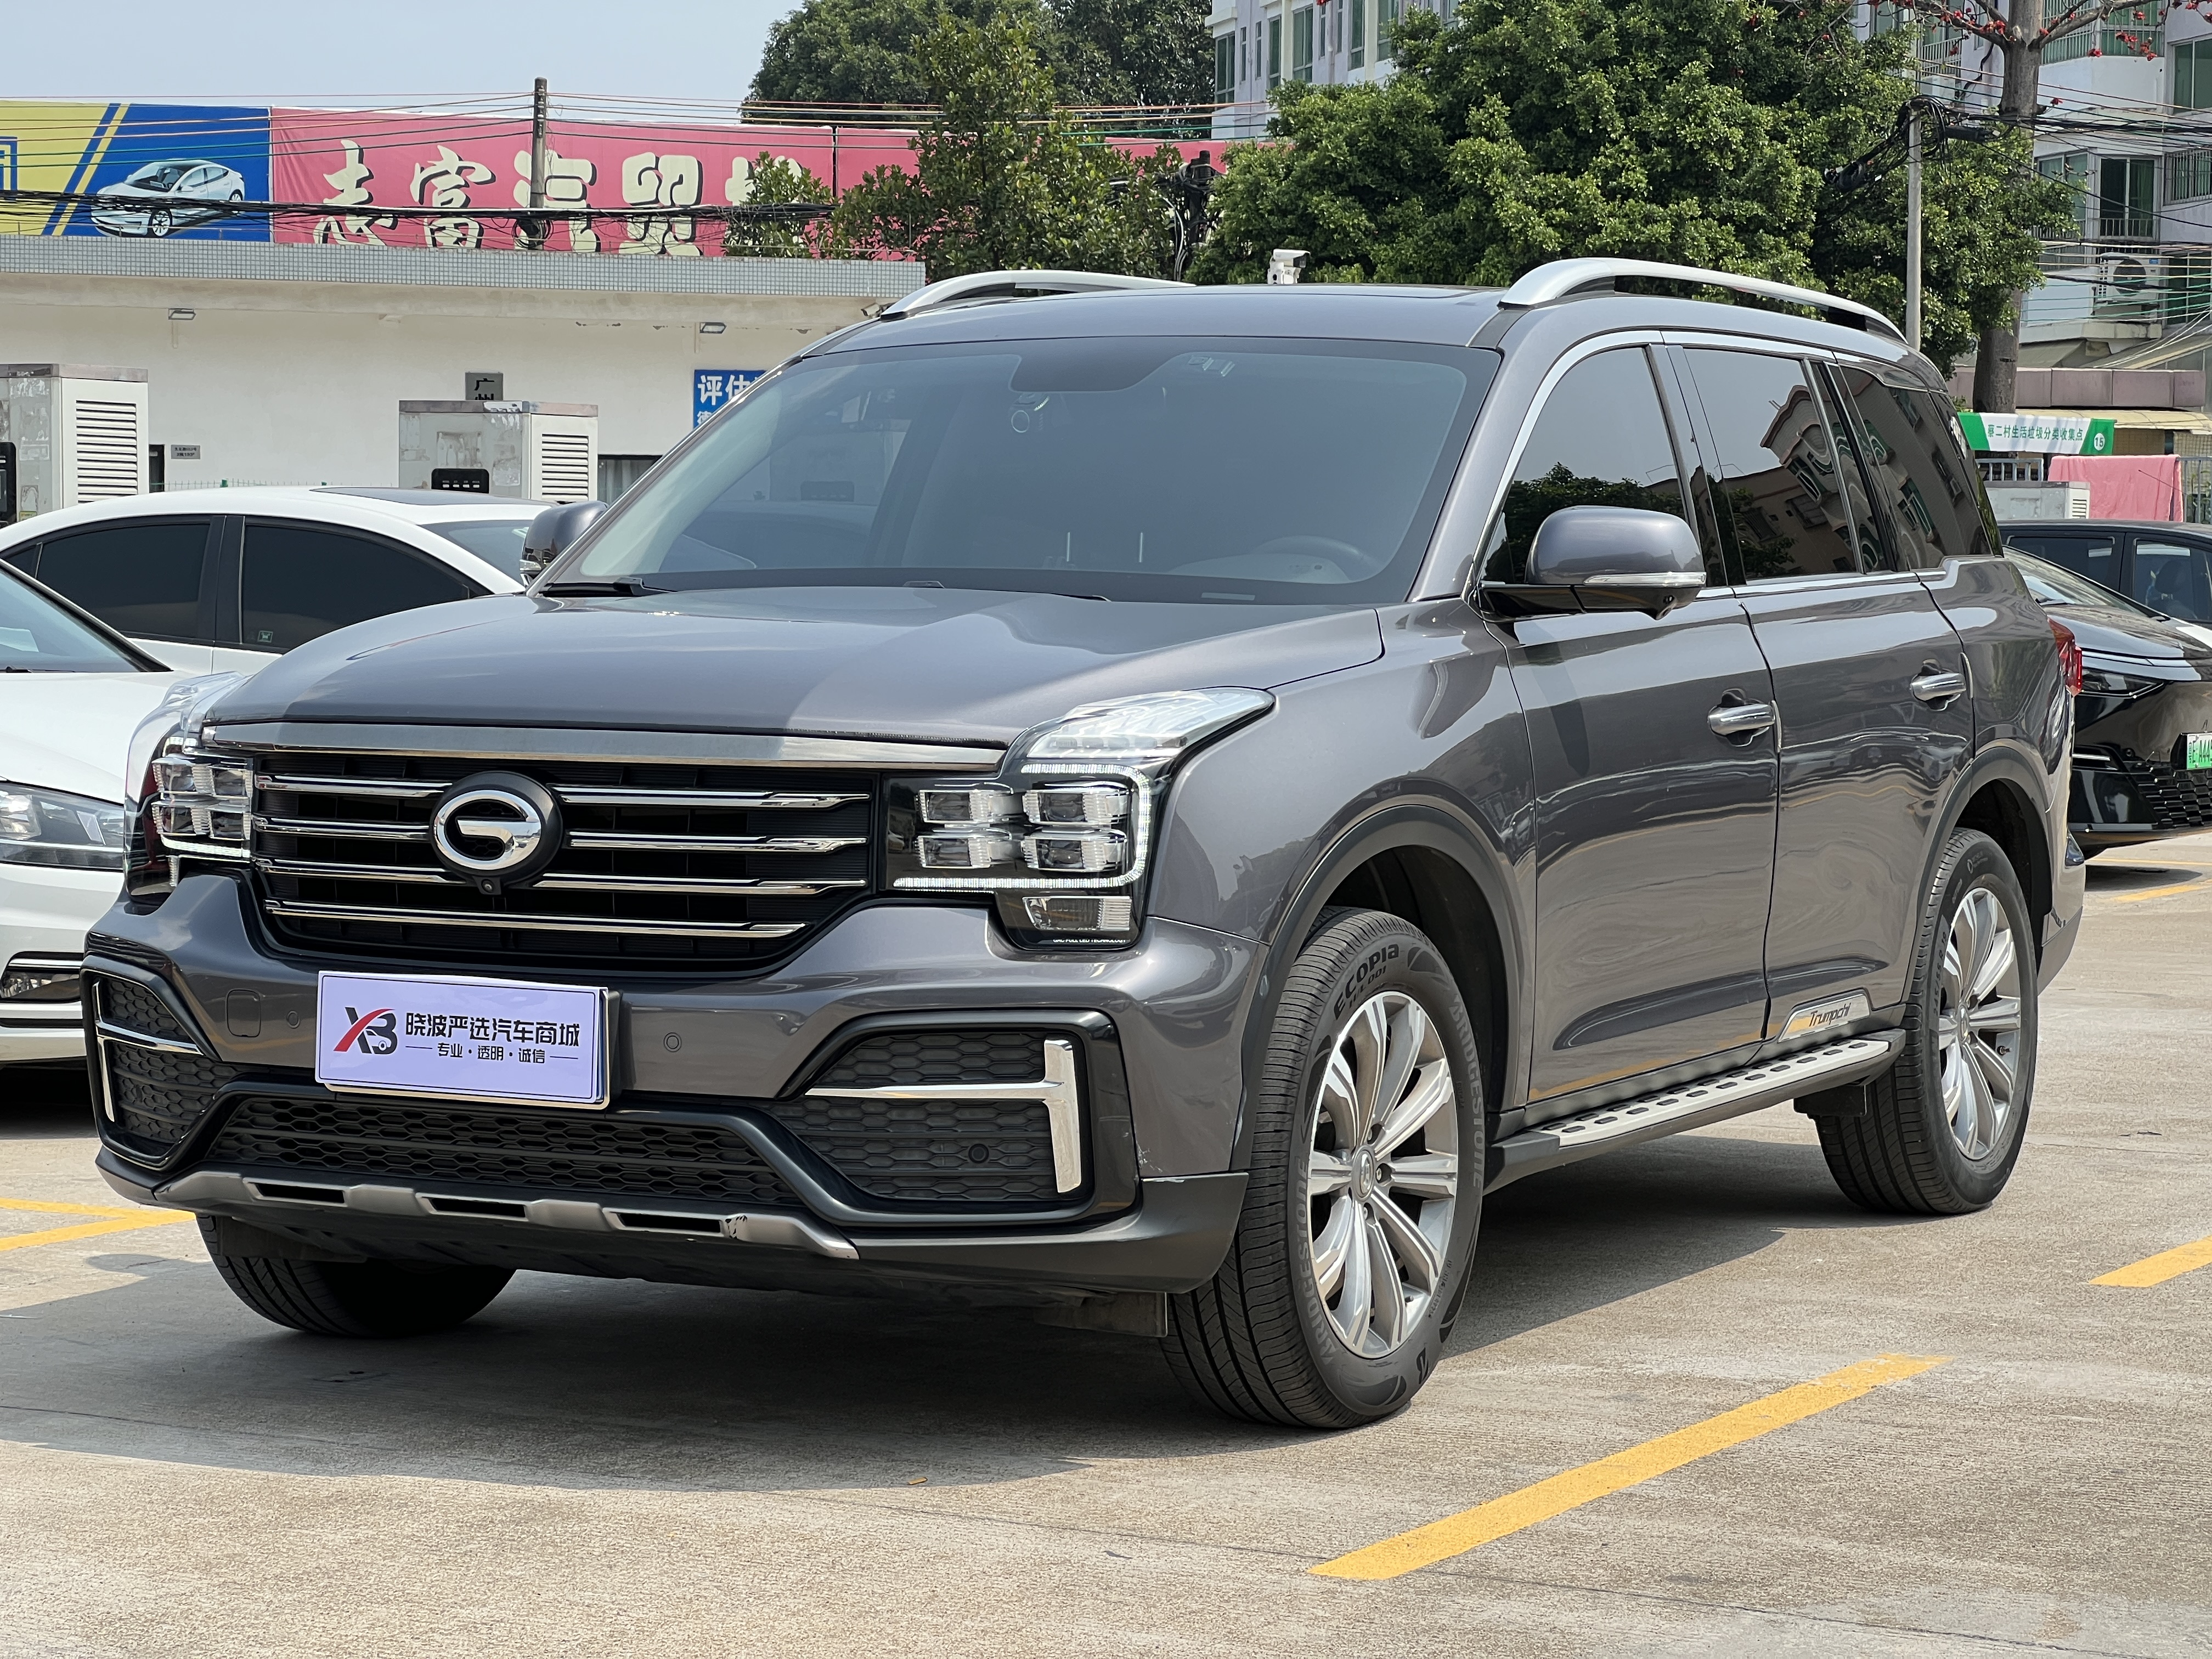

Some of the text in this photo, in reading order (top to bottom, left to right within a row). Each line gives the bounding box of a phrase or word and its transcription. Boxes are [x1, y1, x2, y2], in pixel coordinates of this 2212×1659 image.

[313, 139, 805, 257] 志富汽贸
[698, 375, 757, 405] 评估
[2095, 437, 2103, 447] 15
[1809, 1002, 1851, 1026] Trumpchi
[405, 1012, 580, 1047] 晓波严选汽车商城
